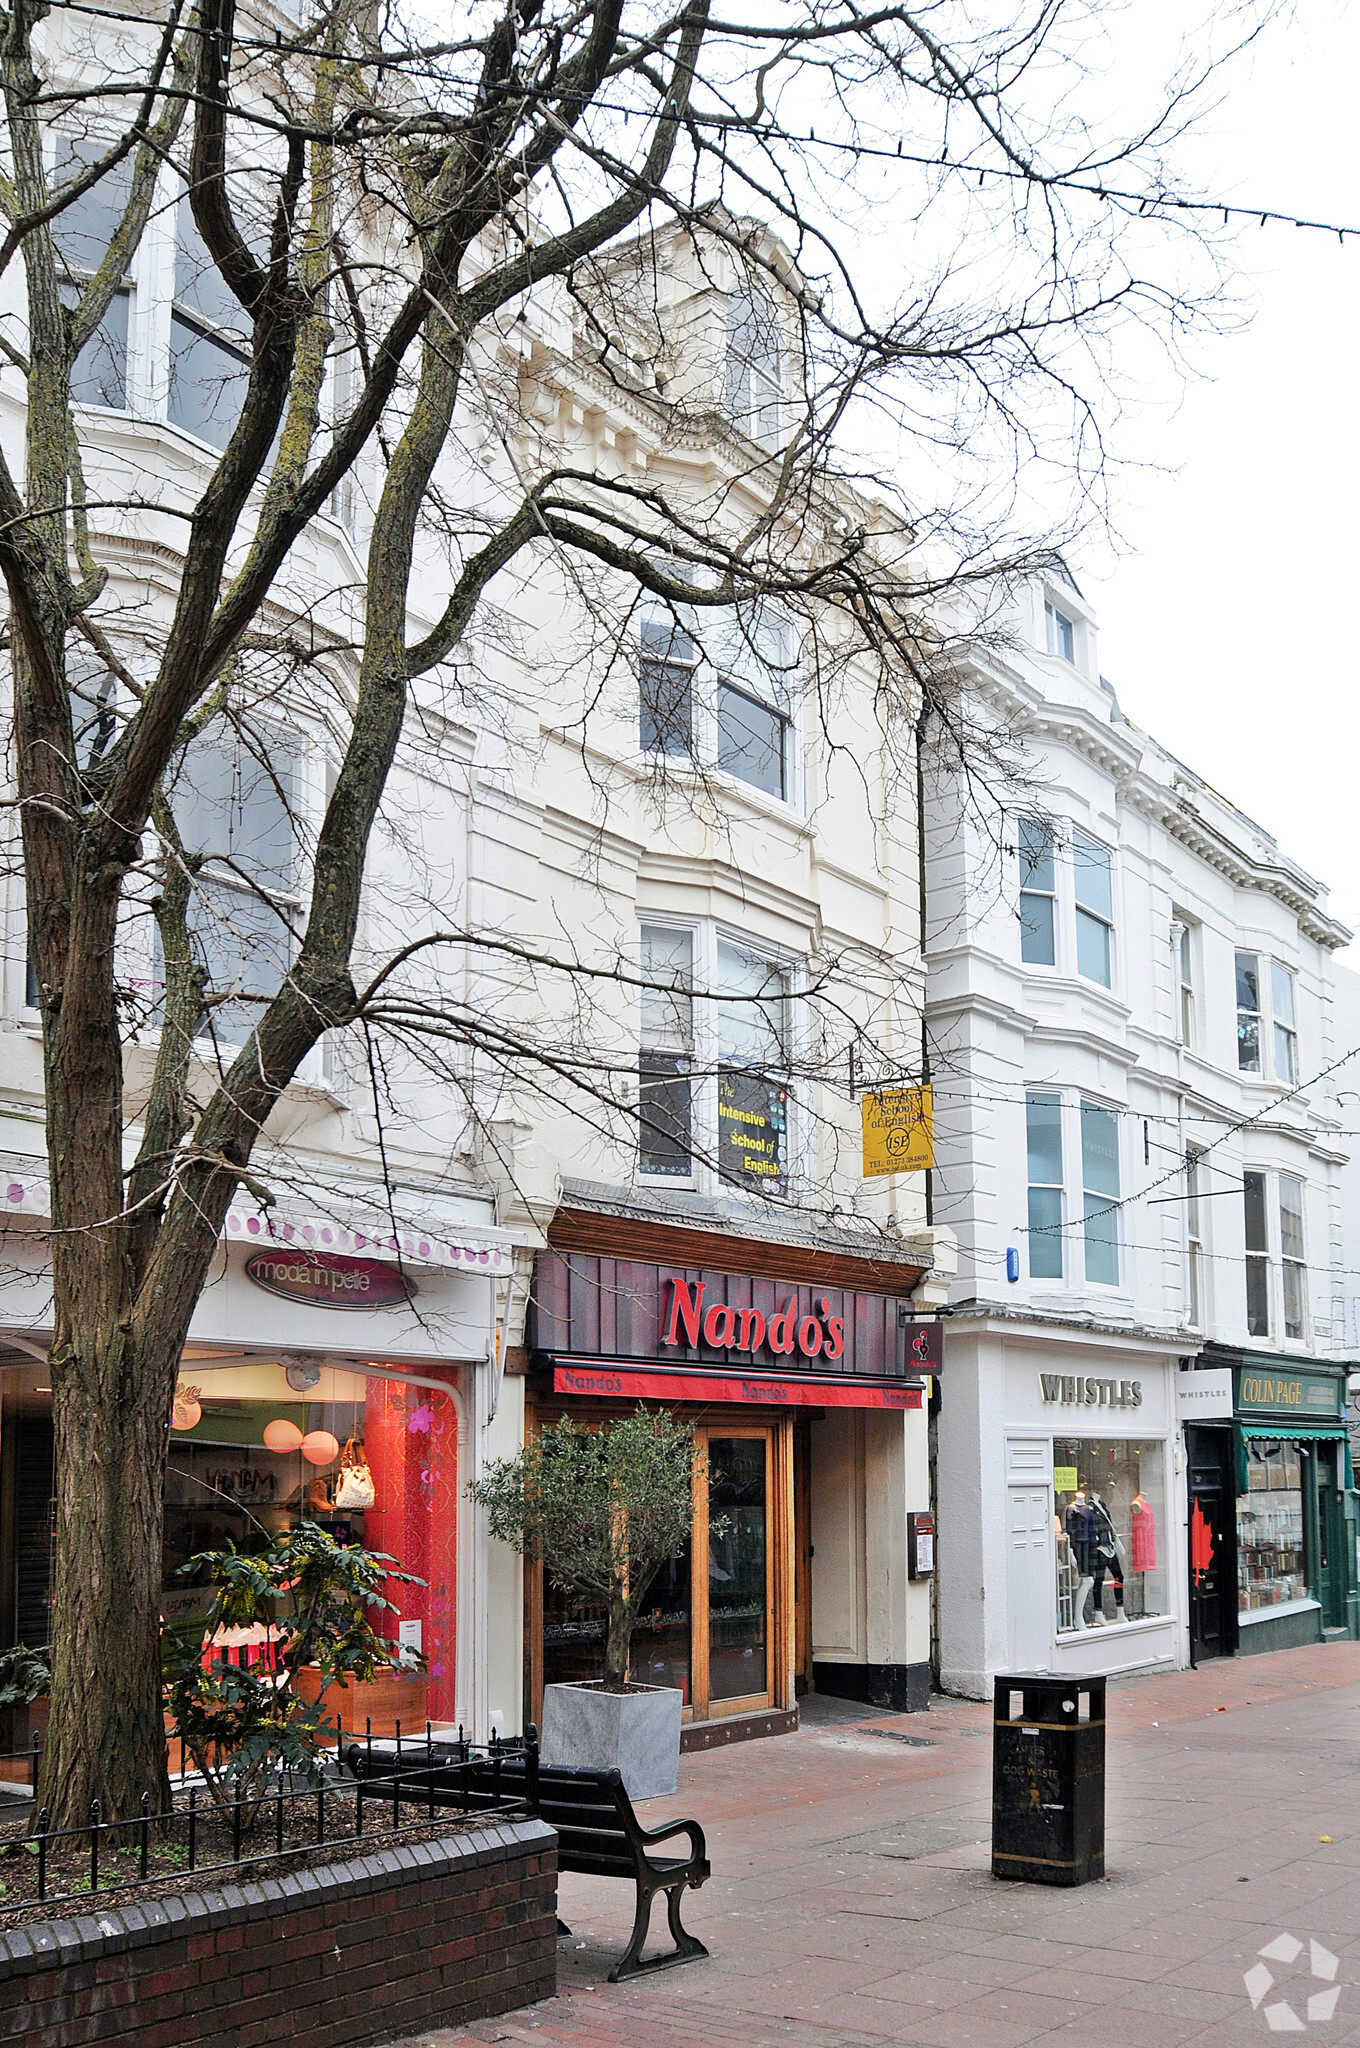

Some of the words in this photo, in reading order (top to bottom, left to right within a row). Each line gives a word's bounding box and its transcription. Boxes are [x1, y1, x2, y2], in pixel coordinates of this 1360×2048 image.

[719, 1102, 766, 1127] Intensive
[880, 1102, 913, 1117] School
[871, 1118, 883, 1128] of
[884, 1112, 924, 1127] English
[730, 1132, 765, 1152] School
[766, 1140, 775, 1158] of
[888, 1135, 909, 1149] ISE
[744, 1155, 780, 1175] English
[256, 1261, 311, 1284] moda
[314, 1267, 329, 1286] in
[331, 1269, 371, 1292] pelle
[660, 1278, 845, 1360] Nando's
[564, 1370, 622, 1392] Nando's
[742, 1381, 787, 1401] Nando's
[1040, 1374, 1142, 1406] WHISTLES
[1243, 1377, 1275, 1402] COLIN
[1276, 1380, 1302, 1404] PAGE
[882, 1390, 919, 1407] Nando's
[1179, 1390, 1227, 1399] WHISTLES
[1003, 1765, 1025, 1775] DOG
[1027, 1767, 1059, 1778] WASTE
